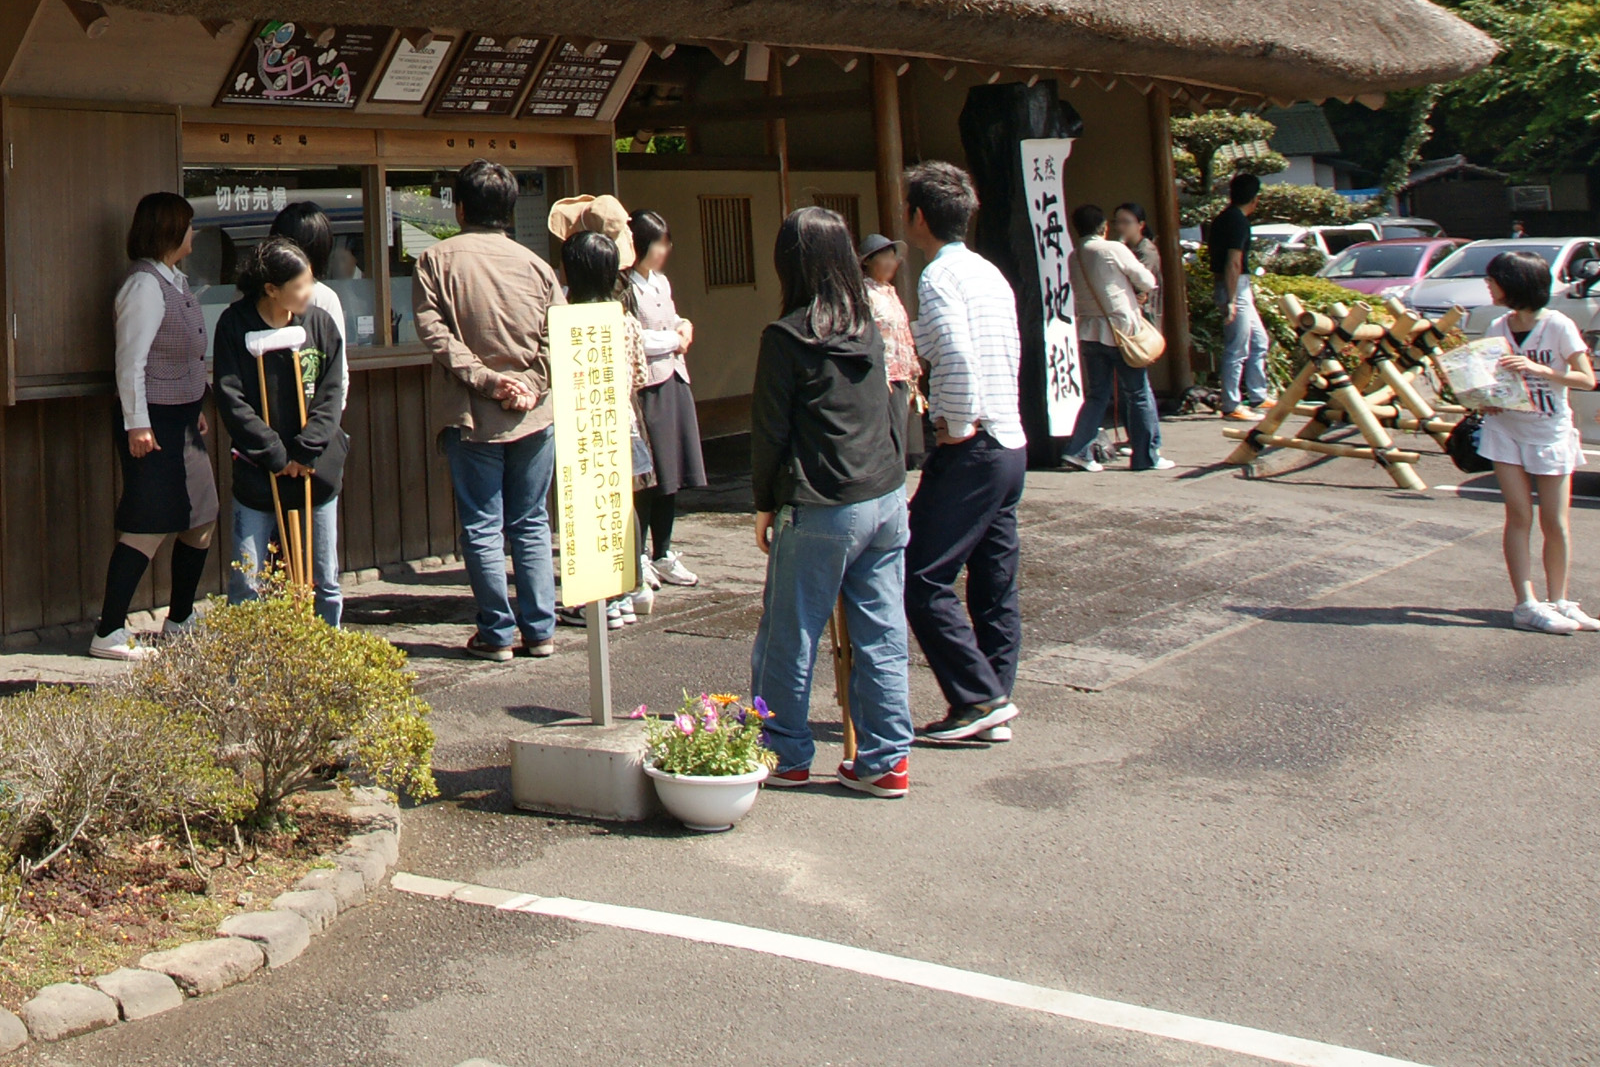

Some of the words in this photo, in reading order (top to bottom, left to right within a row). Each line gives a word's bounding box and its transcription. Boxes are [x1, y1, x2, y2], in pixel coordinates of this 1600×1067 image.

[216, 185, 288, 212] 切符売場
[440, 187, 453, 209] 切
[1035, 191, 1081, 402] 海地獄
[570, 327, 589, 475] 堅く禁止します
[586, 325, 609, 552] その他の行為については
